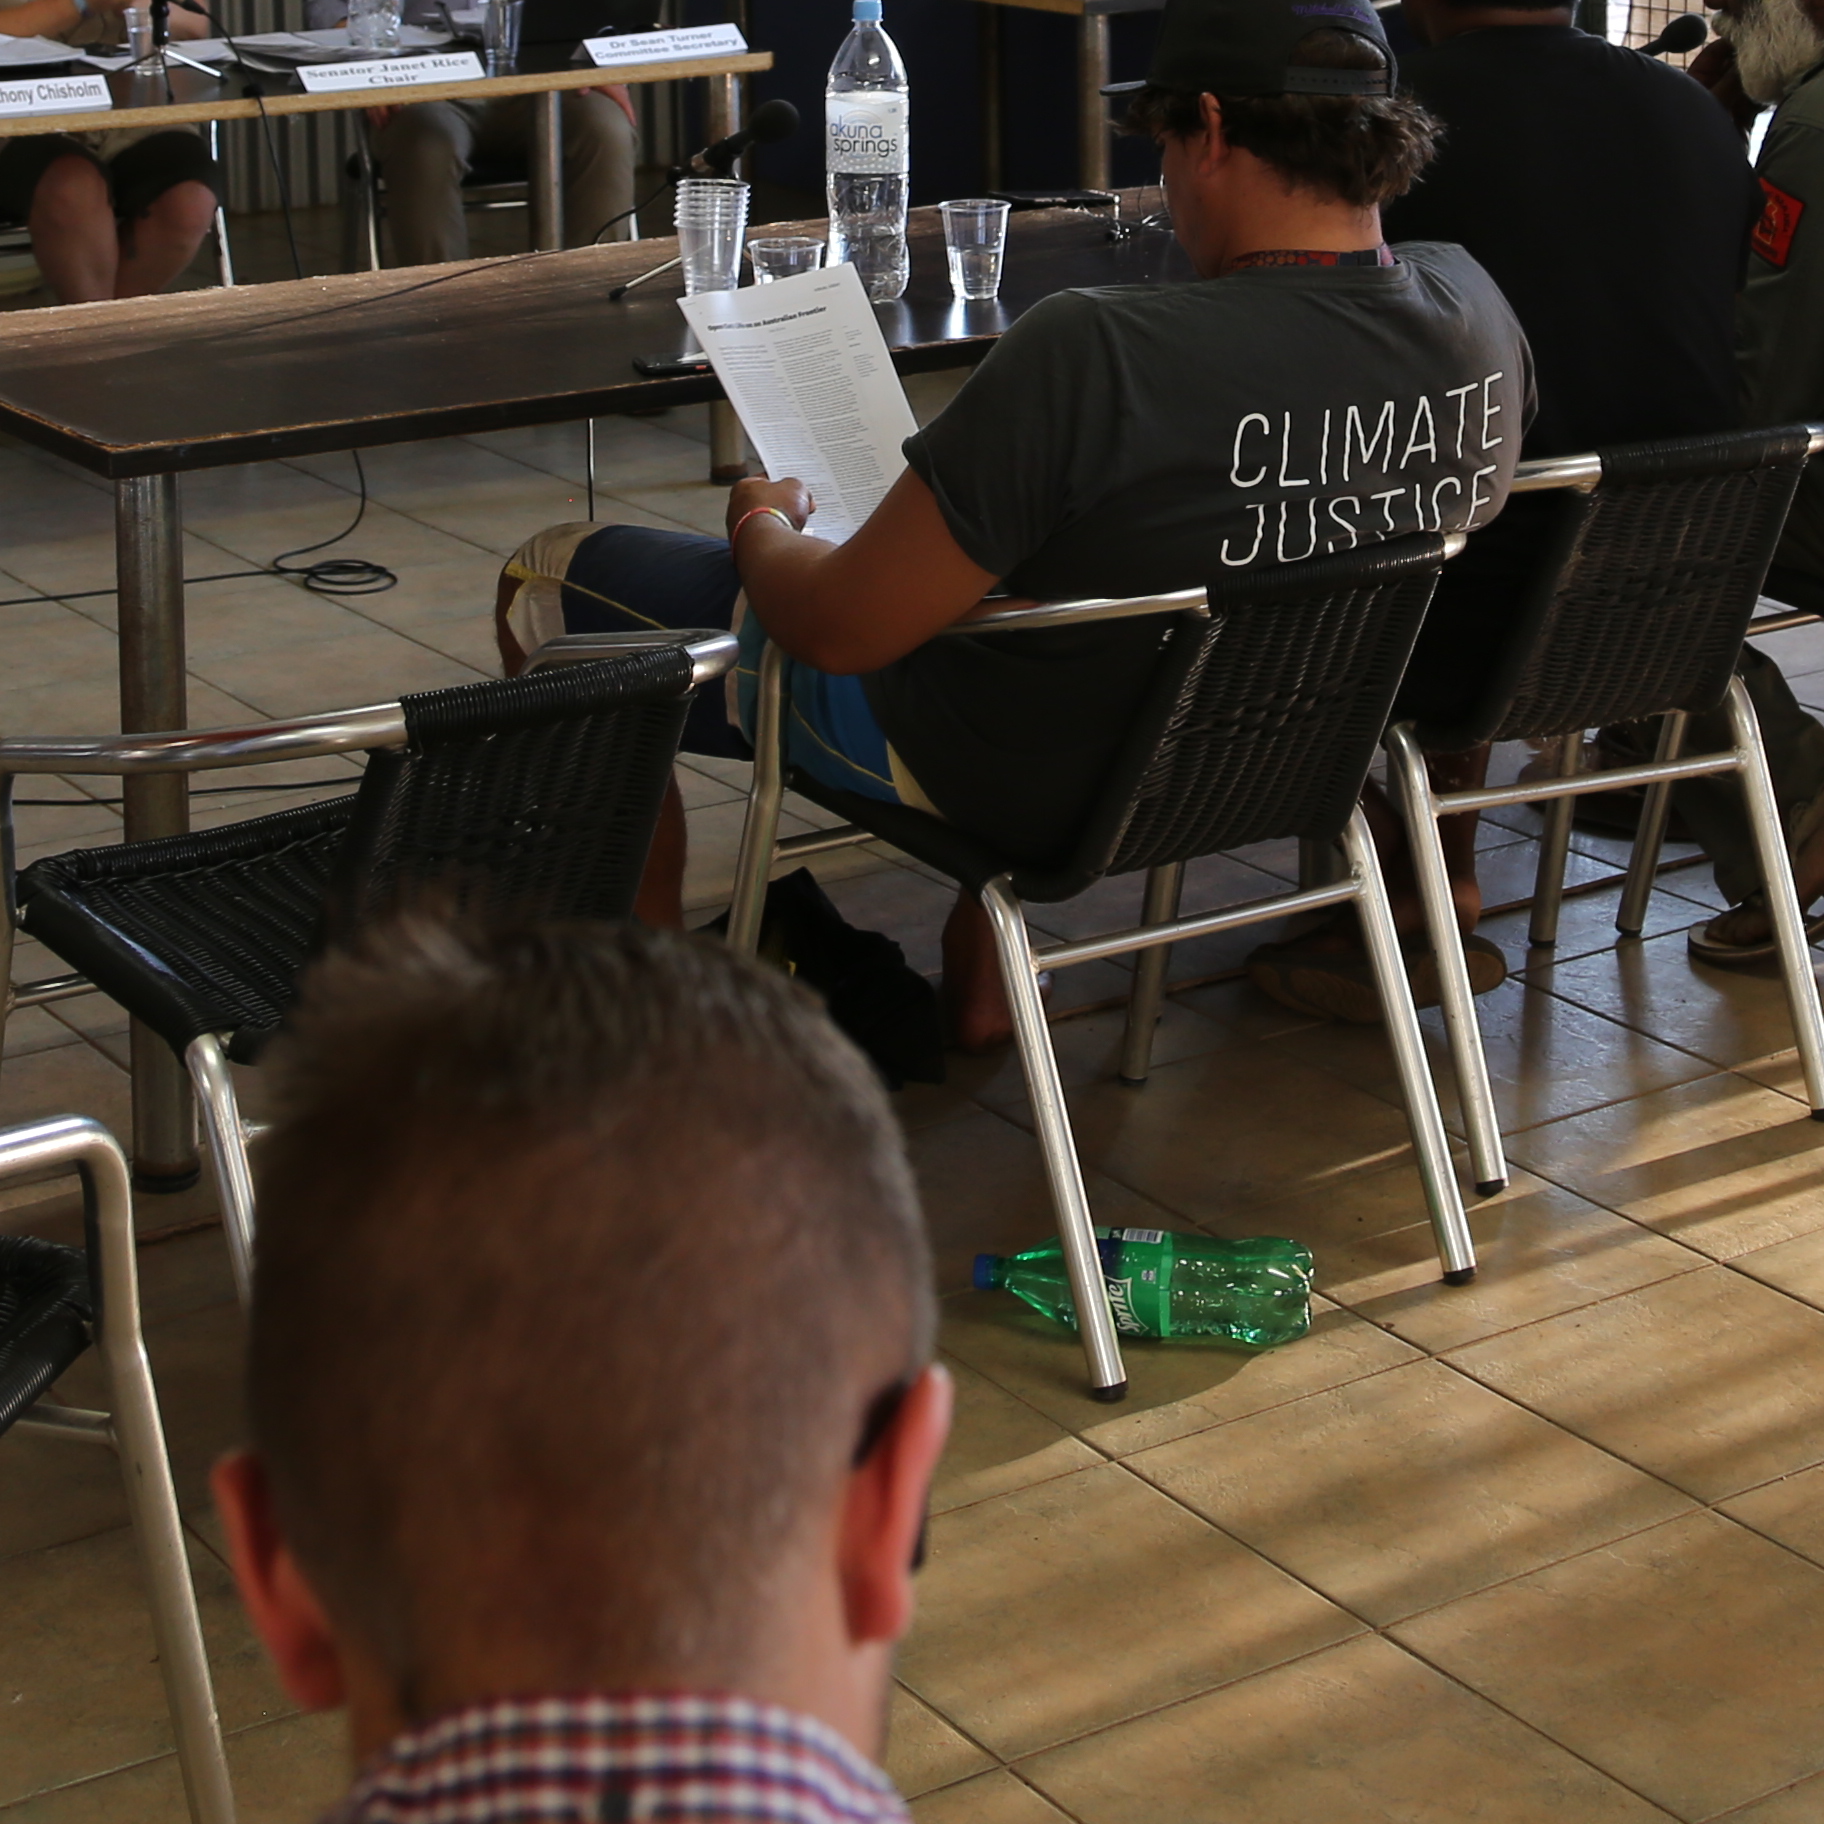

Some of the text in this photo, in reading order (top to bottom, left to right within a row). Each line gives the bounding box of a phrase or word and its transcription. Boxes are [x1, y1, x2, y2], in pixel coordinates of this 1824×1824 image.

[595, 38, 739, 60] Committee Secretary
[609, 32, 713, 50] Dr Sean Turner
[306, 57, 470, 80] Senator Janet Rice
[369, 74, 418, 85] Chair
[37, 81, 102, 101] Chisholm
[830, 115, 883, 139] akuna
[833, 135, 898, 158] springs
[762, 314, 797, 326] Australian
[798, 306, 827, 318] Frontier
[1230, 371, 1504, 488] CLIMATE
[1220, 464, 1497, 567] JUSTICE
[1107, 1283, 1141, 1333] Sprite
